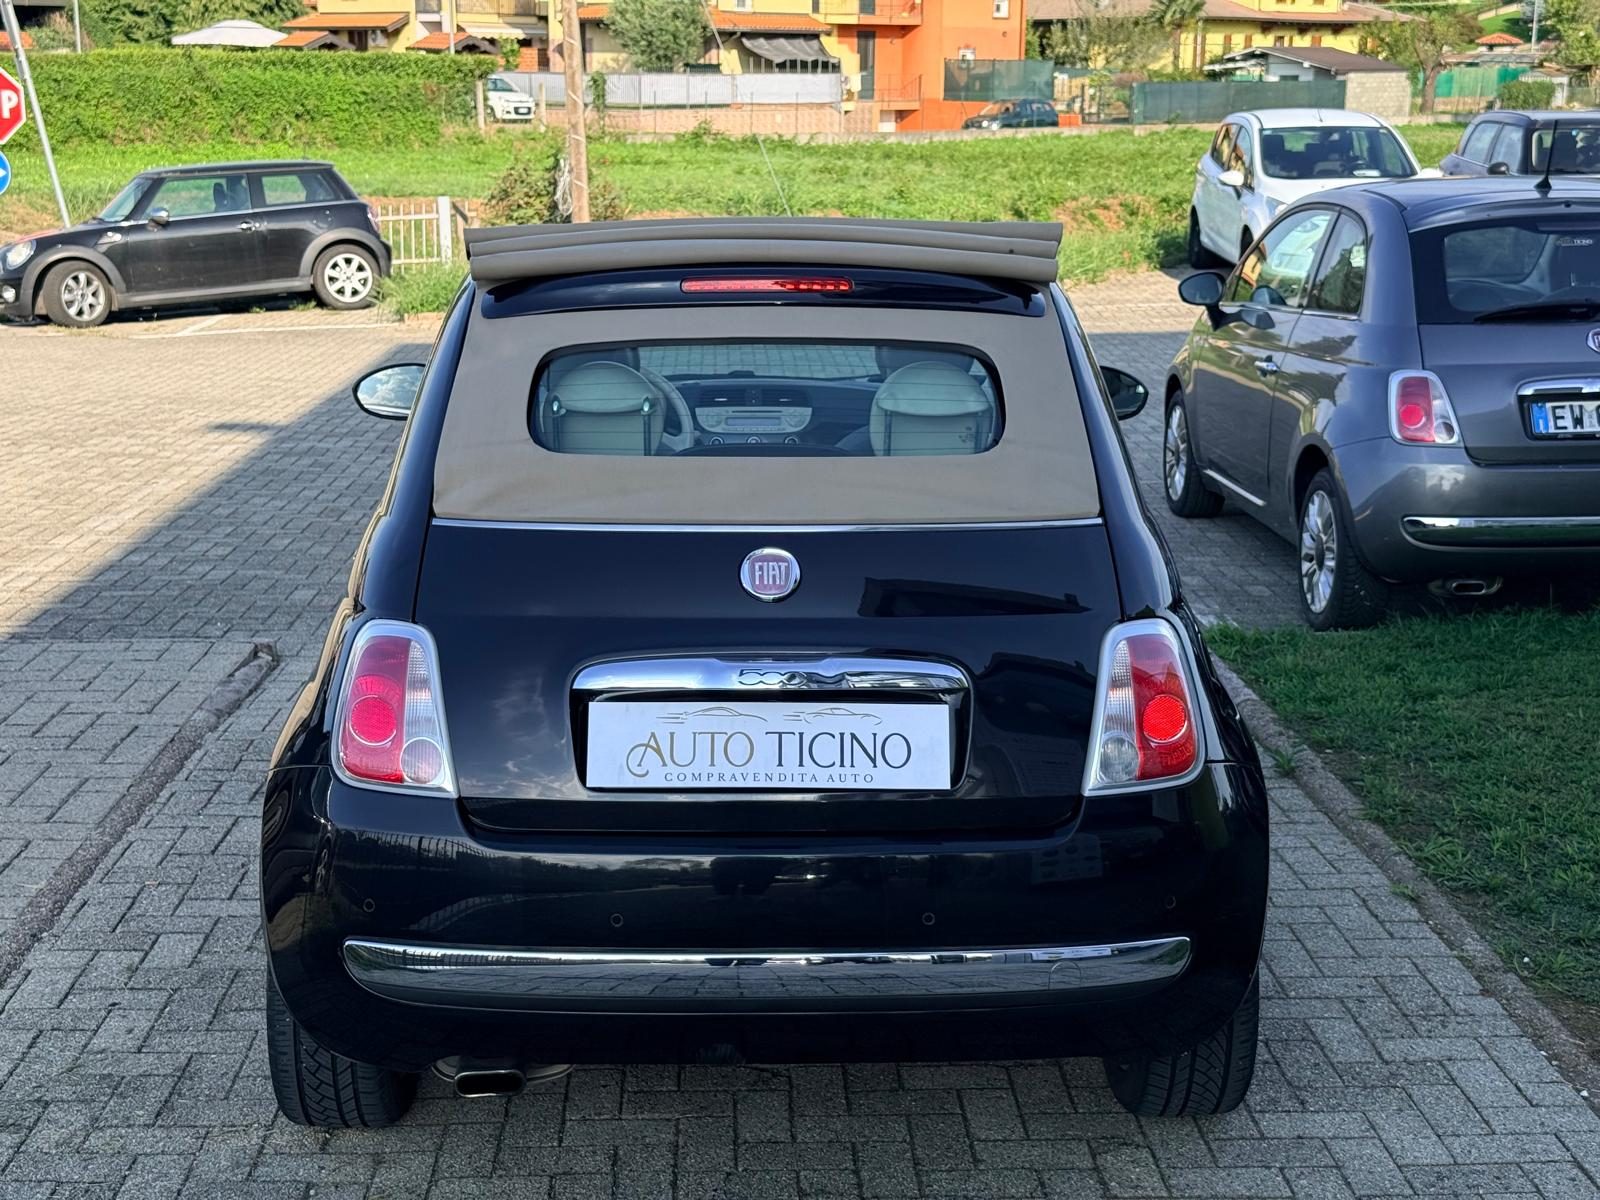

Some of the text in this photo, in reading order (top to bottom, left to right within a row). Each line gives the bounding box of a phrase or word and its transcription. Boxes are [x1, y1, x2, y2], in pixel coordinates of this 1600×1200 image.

[1551, 404, 1600, 430] EW
[754, 561, 789, 585] FIAT
[626, 731, 912, 778] AUTO TICINO
[664, 772, 875, 784] COMPRAVENDITA AUTO
